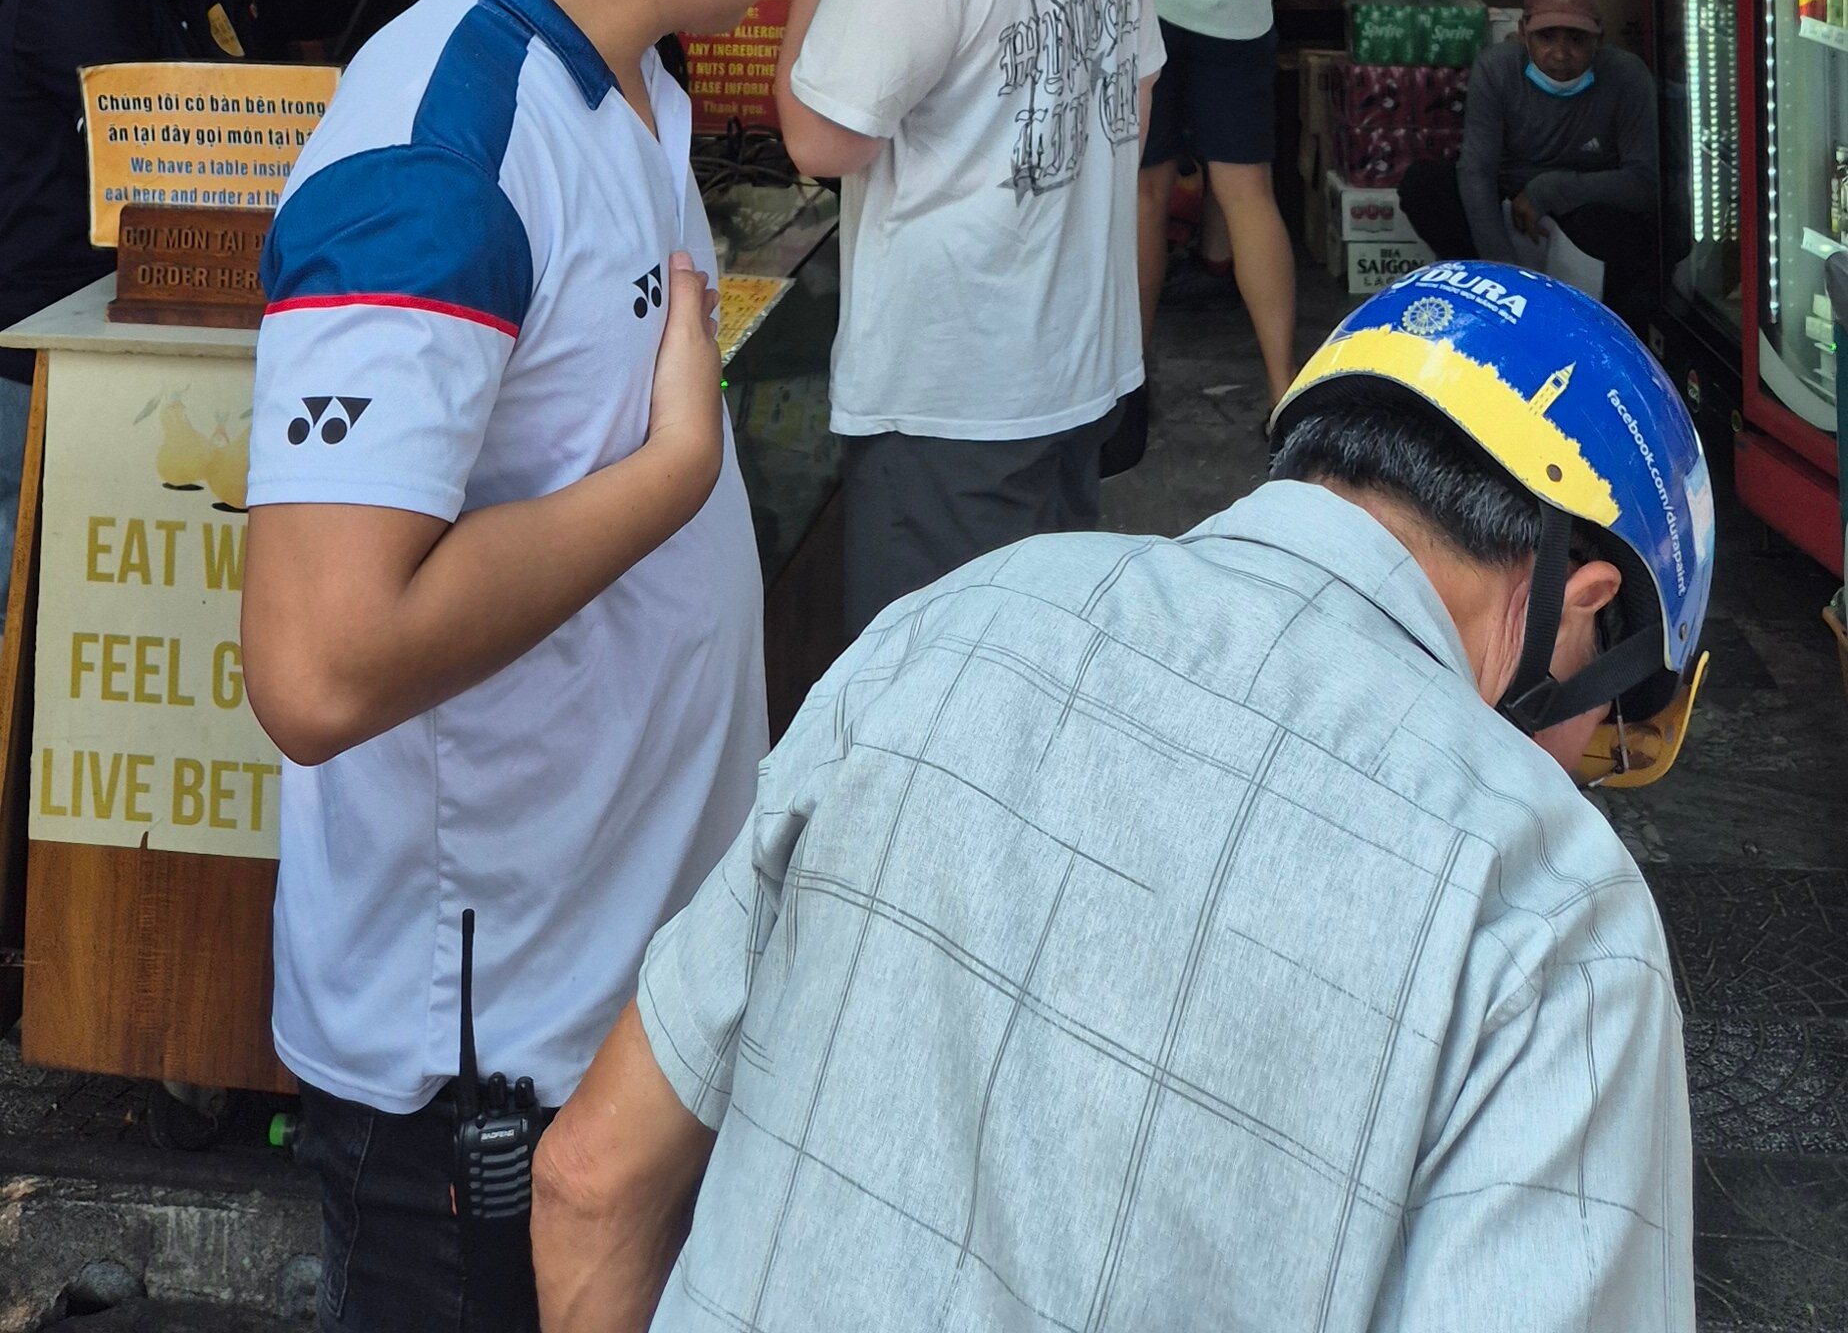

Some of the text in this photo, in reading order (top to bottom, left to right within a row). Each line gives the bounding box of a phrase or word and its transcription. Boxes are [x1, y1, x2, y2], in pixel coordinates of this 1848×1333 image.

[1431, 24, 1475, 43] Sprite
[688, 42, 779, 58] ANY INGREDIENT
[696, 62, 776, 77] NUTS OR OTHE
[689, 80, 769, 95] LEASE INFORM
[98, 92, 326, 117] Chúng tôi có bàn bên trong
[703, 100, 739, 113] Thank
[133, 124, 156, 146] tại
[196, 125, 222, 148] gọi
[227, 126, 263, 145] món
[268, 128, 290, 150] tại
[131, 156, 153, 173] We
[157, 157, 193, 174] have
[198, 161, 206, 175] a
[210, 159, 248, 176] table
[105, 185, 280, 206] eat here and order at th
[123, 226, 158, 252] GỌI
[163, 224, 209, 251] MÓN
[216, 229, 246, 254] TẠI
[138, 265, 261, 291] ORDER HER
[1420, 269, 1527, 318] DURA
[1606, 389, 1686, 597] facebook.com/durapaint
[86, 516, 187, 587] EAT
[70, 632, 195, 707] FEEL
[40, 747, 156, 823] LIVE
